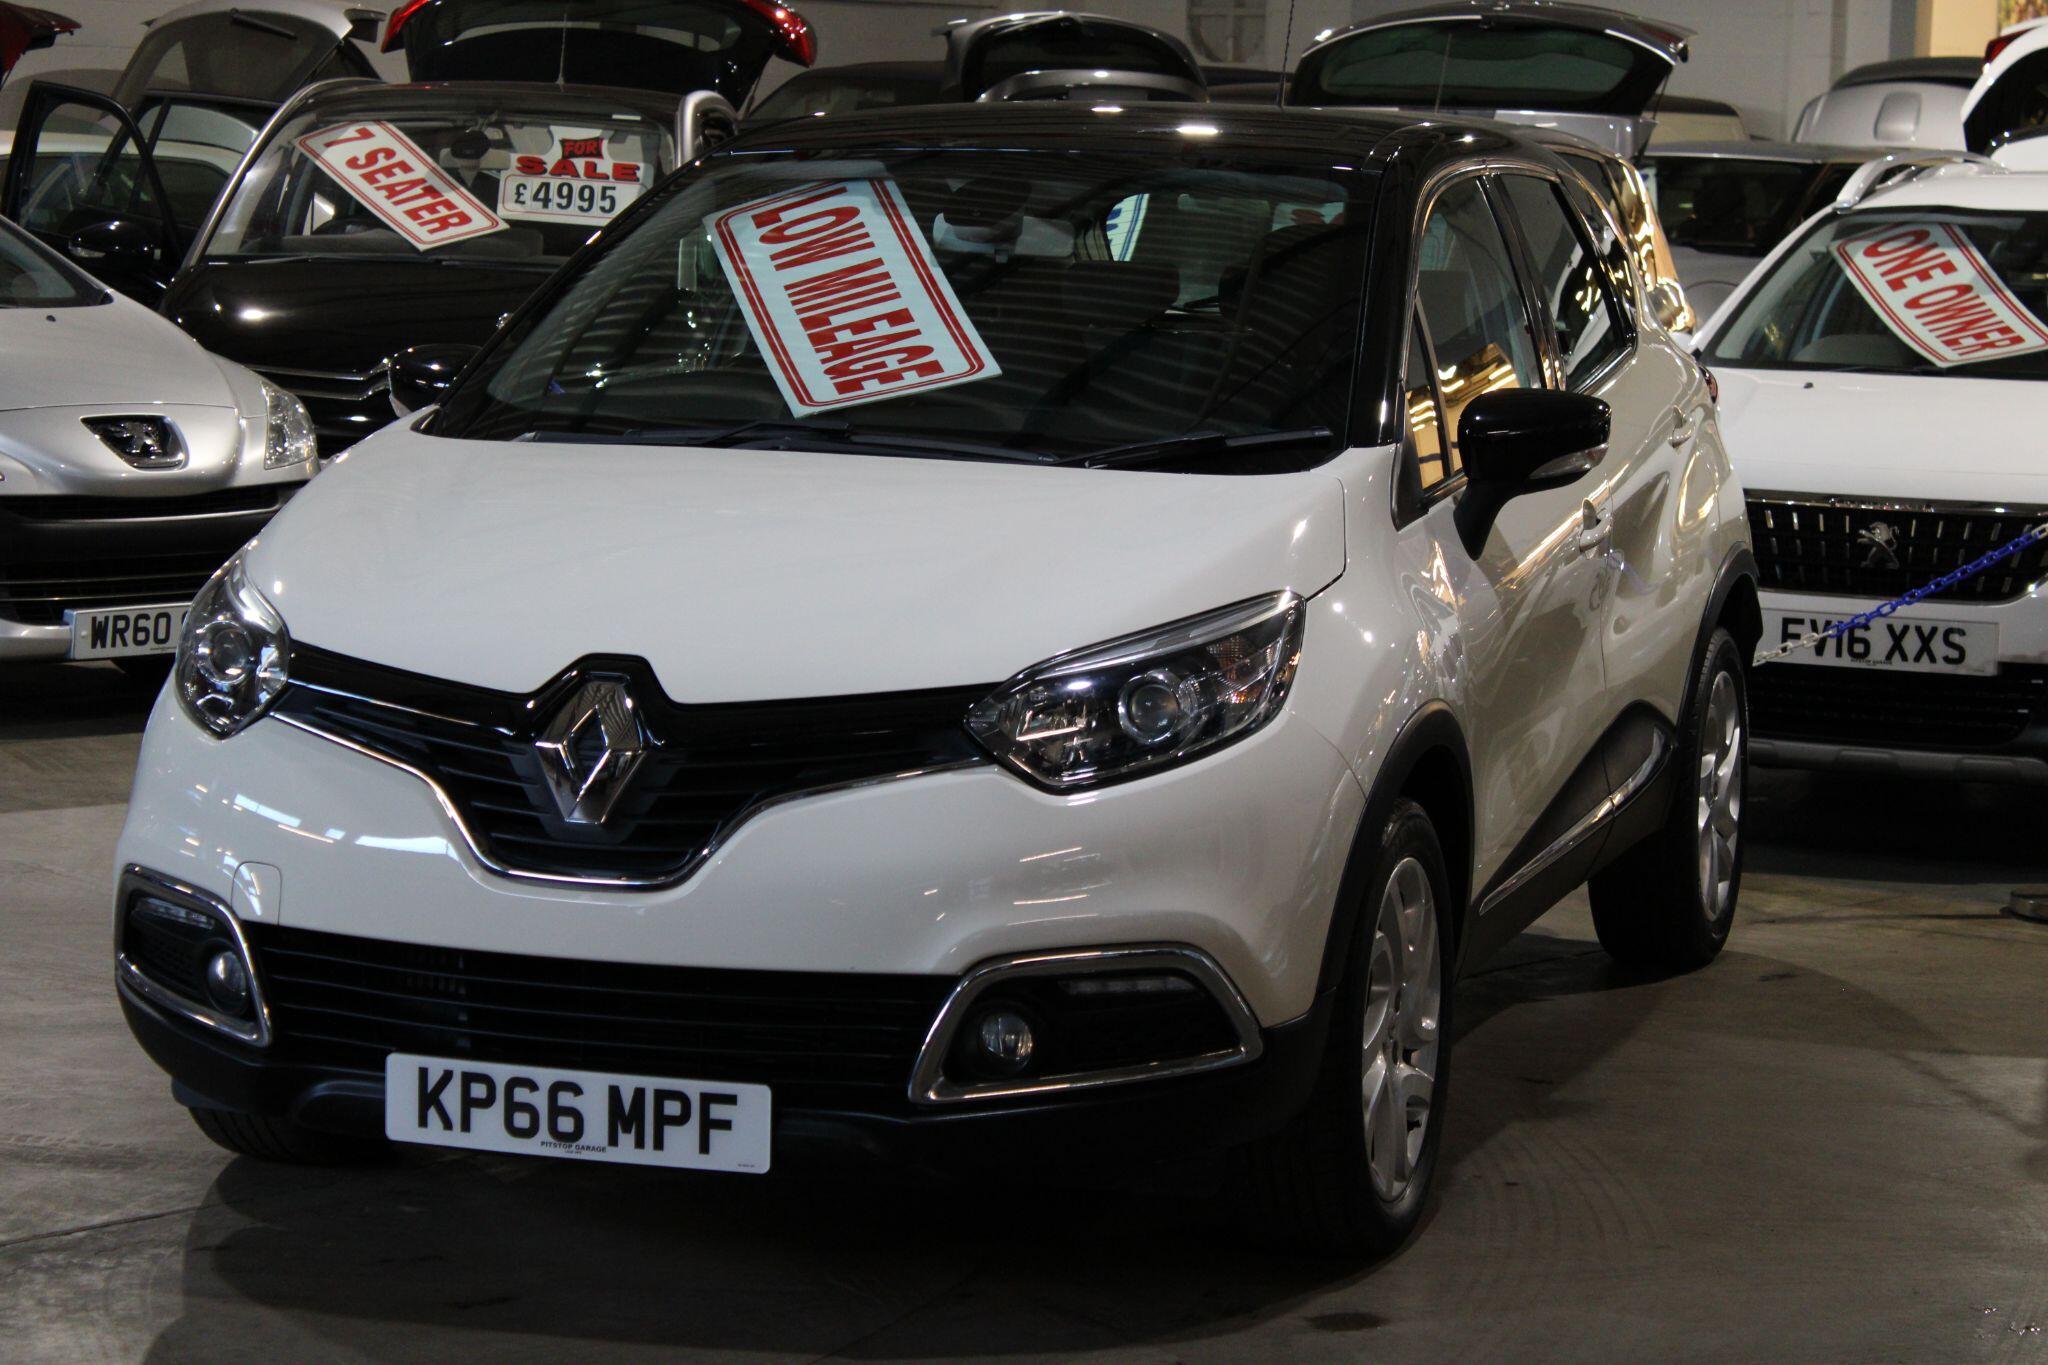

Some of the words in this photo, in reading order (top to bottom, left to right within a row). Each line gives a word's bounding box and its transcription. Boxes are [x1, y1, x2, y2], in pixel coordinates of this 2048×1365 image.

[323, 127, 377, 148] 7
[564, 140, 598, 156] FOR
[515, 155, 641, 182] SALE
[345, 147, 473, 237] SEATER
[514, 181, 617, 214] £4995
[751, 186, 876, 272] LOW
[1862, 229, 1958, 292] ONE
[783, 257, 945, 395] MILEAGE
[1903, 284, 2026, 357] OWNER
[91, 611, 172, 650] WR60
[1884, 623, 1967, 666] XXS
[418, 1066, 585, 1144] KP66
[607, 1084, 738, 1155] MPF
[540, 1140, 573, 1150] PITSTOP
[574, 1143, 607, 1153] GARAGE
